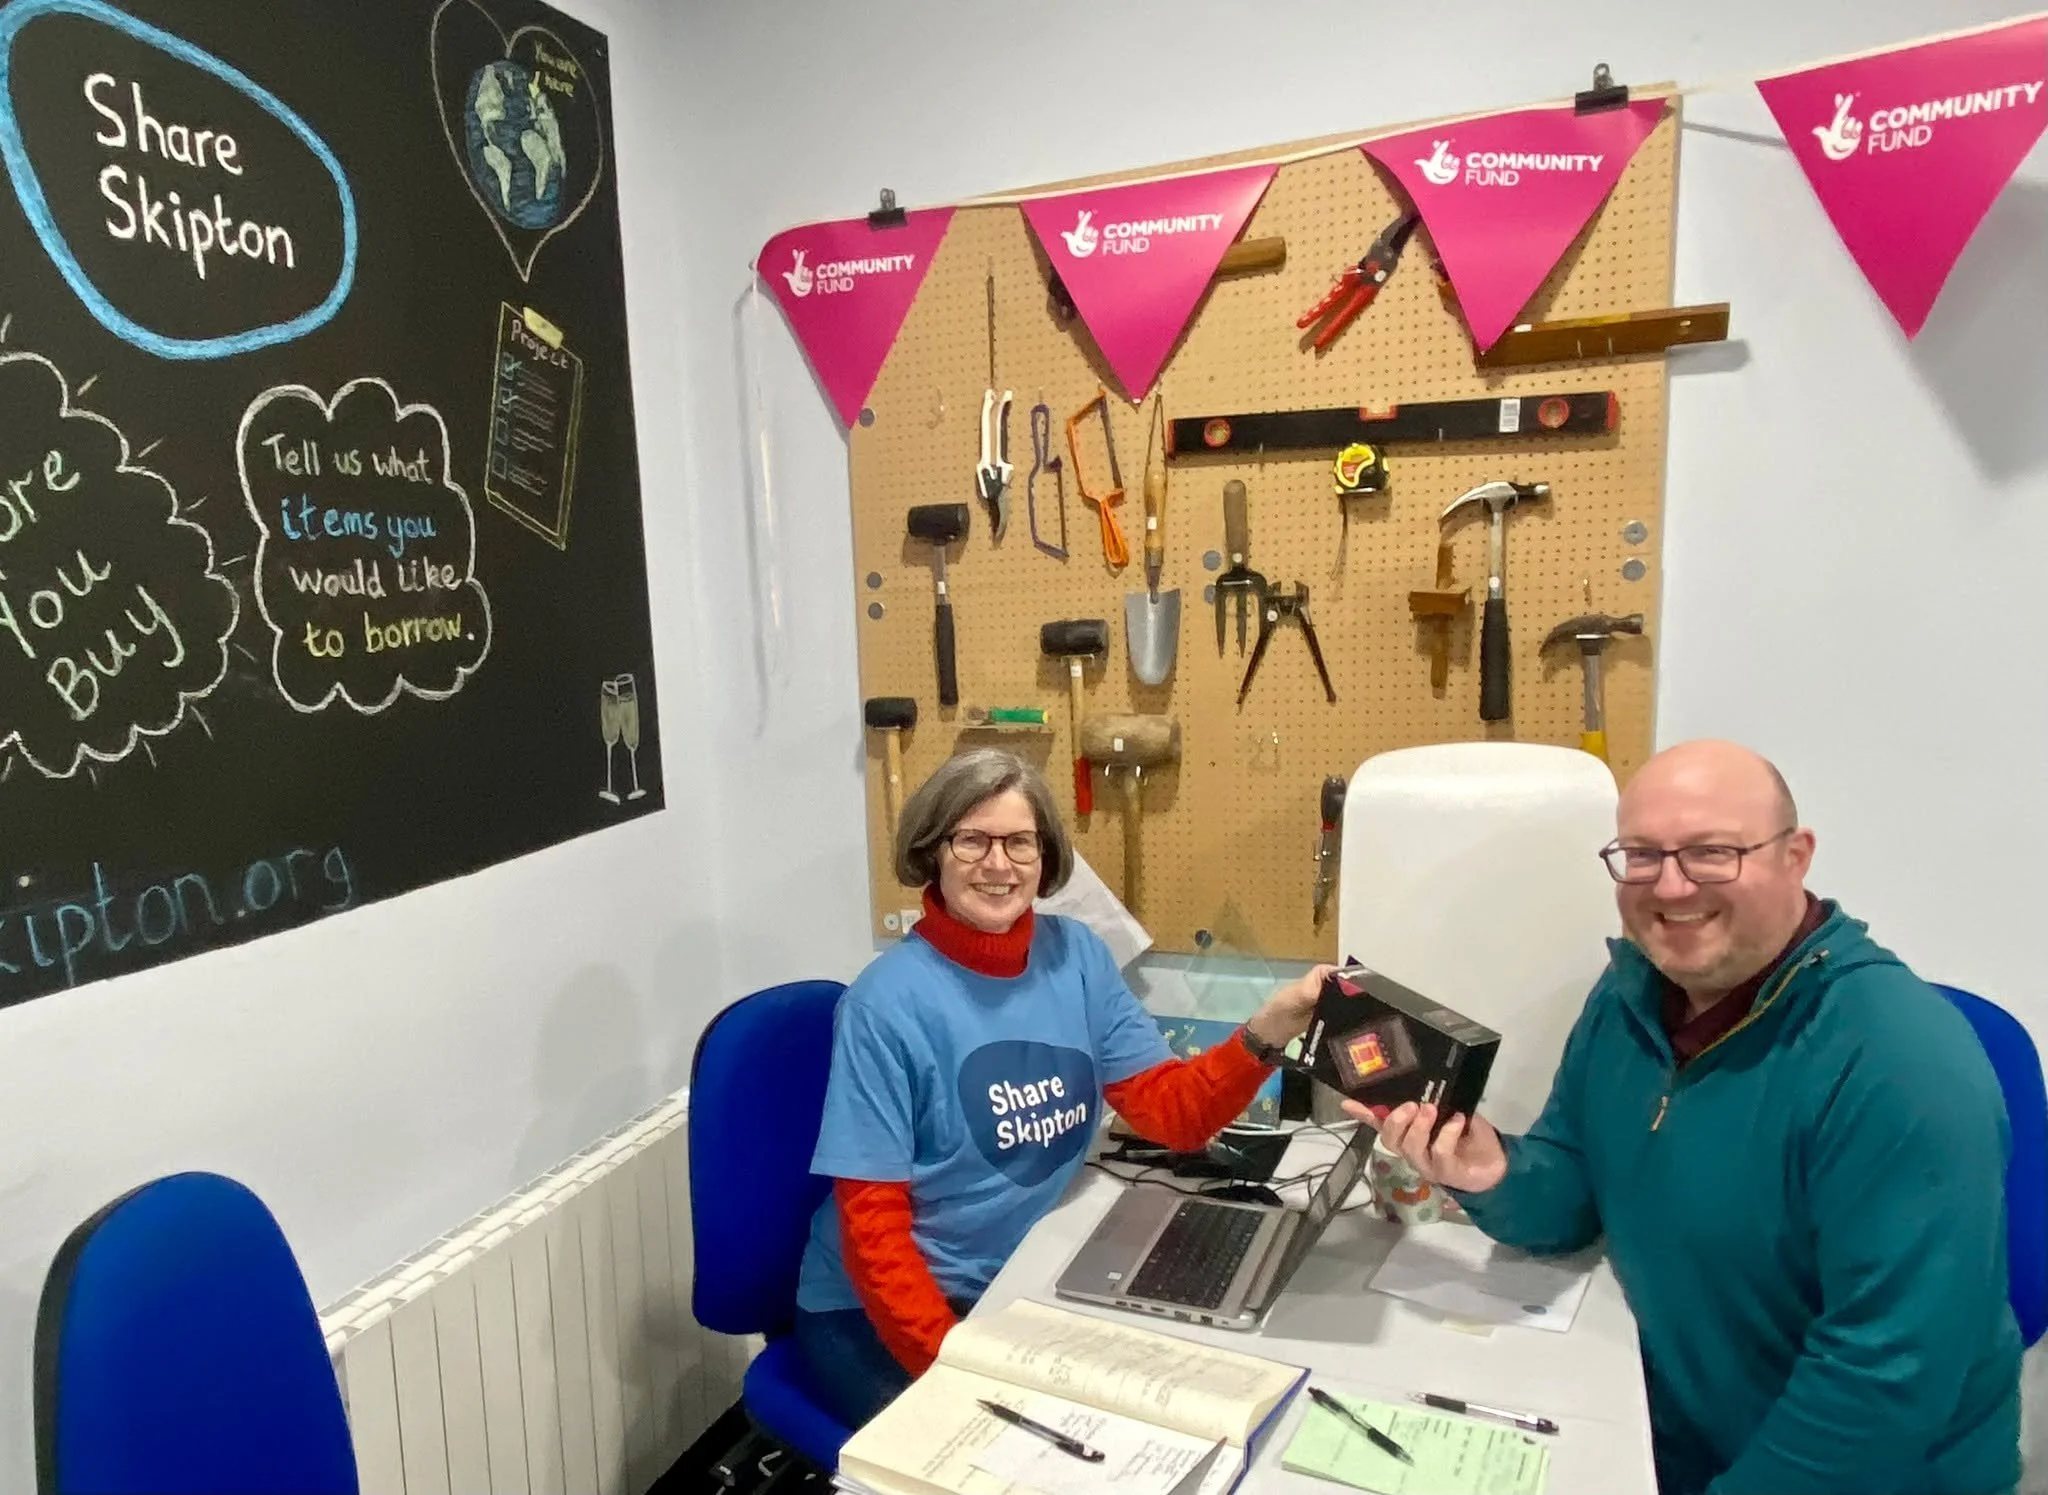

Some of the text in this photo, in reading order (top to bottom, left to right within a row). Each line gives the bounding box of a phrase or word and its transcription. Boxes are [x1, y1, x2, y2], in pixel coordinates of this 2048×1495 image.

[84, 73, 243, 175] Share
[1869, 81, 2043, 134] COMMUNITY
[1867, 125, 1932, 156] FUND
[1464, 169, 1520, 187] FUND
[1465, 152, 1604, 174] COMMUNITY
[100, 164, 295, 280] Skipton
[1102, 212, 1224, 241] COMMUNITY
[815, 254, 915, 281] COMMUNITY
[1101, 236, 1150, 257] FUND
[815, 276, 855, 296] FUND
[262, 433, 432, 484] Tell us what
[281, 493, 437, 559] items you
[288, 557, 386, 599] would
[46, 583, 186, 722] Buy
[303, 611, 476, 658] to borrow.
[988, 1075, 1065, 1116] Share
[996, 1102, 1087, 1150] Skipton
